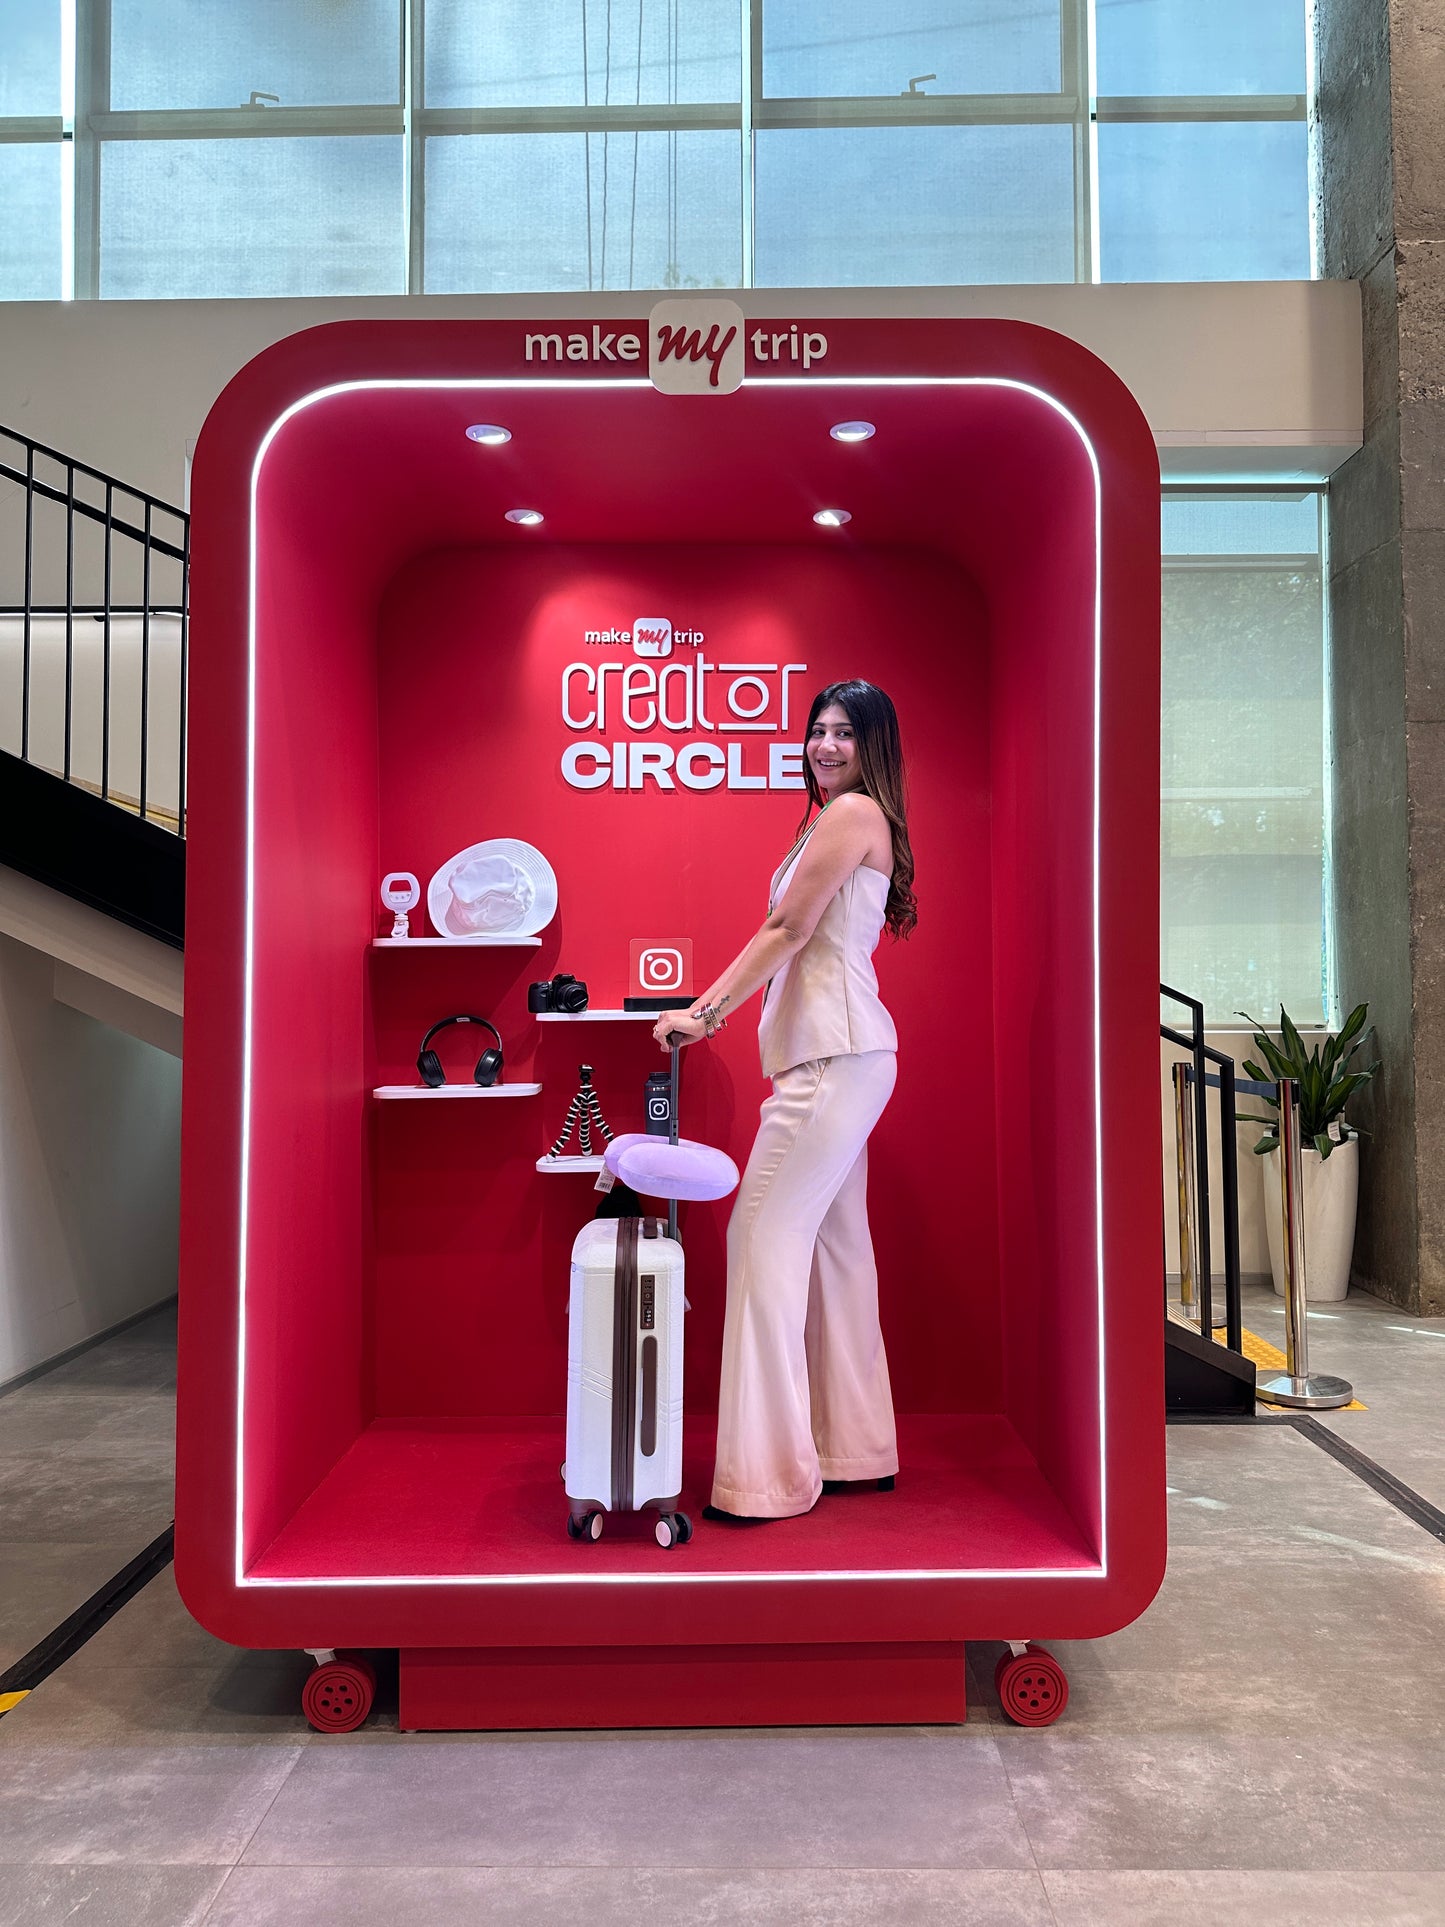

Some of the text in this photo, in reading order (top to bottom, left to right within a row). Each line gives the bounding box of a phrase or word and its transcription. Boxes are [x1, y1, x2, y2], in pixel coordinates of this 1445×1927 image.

[525, 324, 828, 387] make my trip
[585, 628, 704, 654] make my trip
[562, 653, 807, 730] creator
[561, 741, 807, 790] CIRCLE
